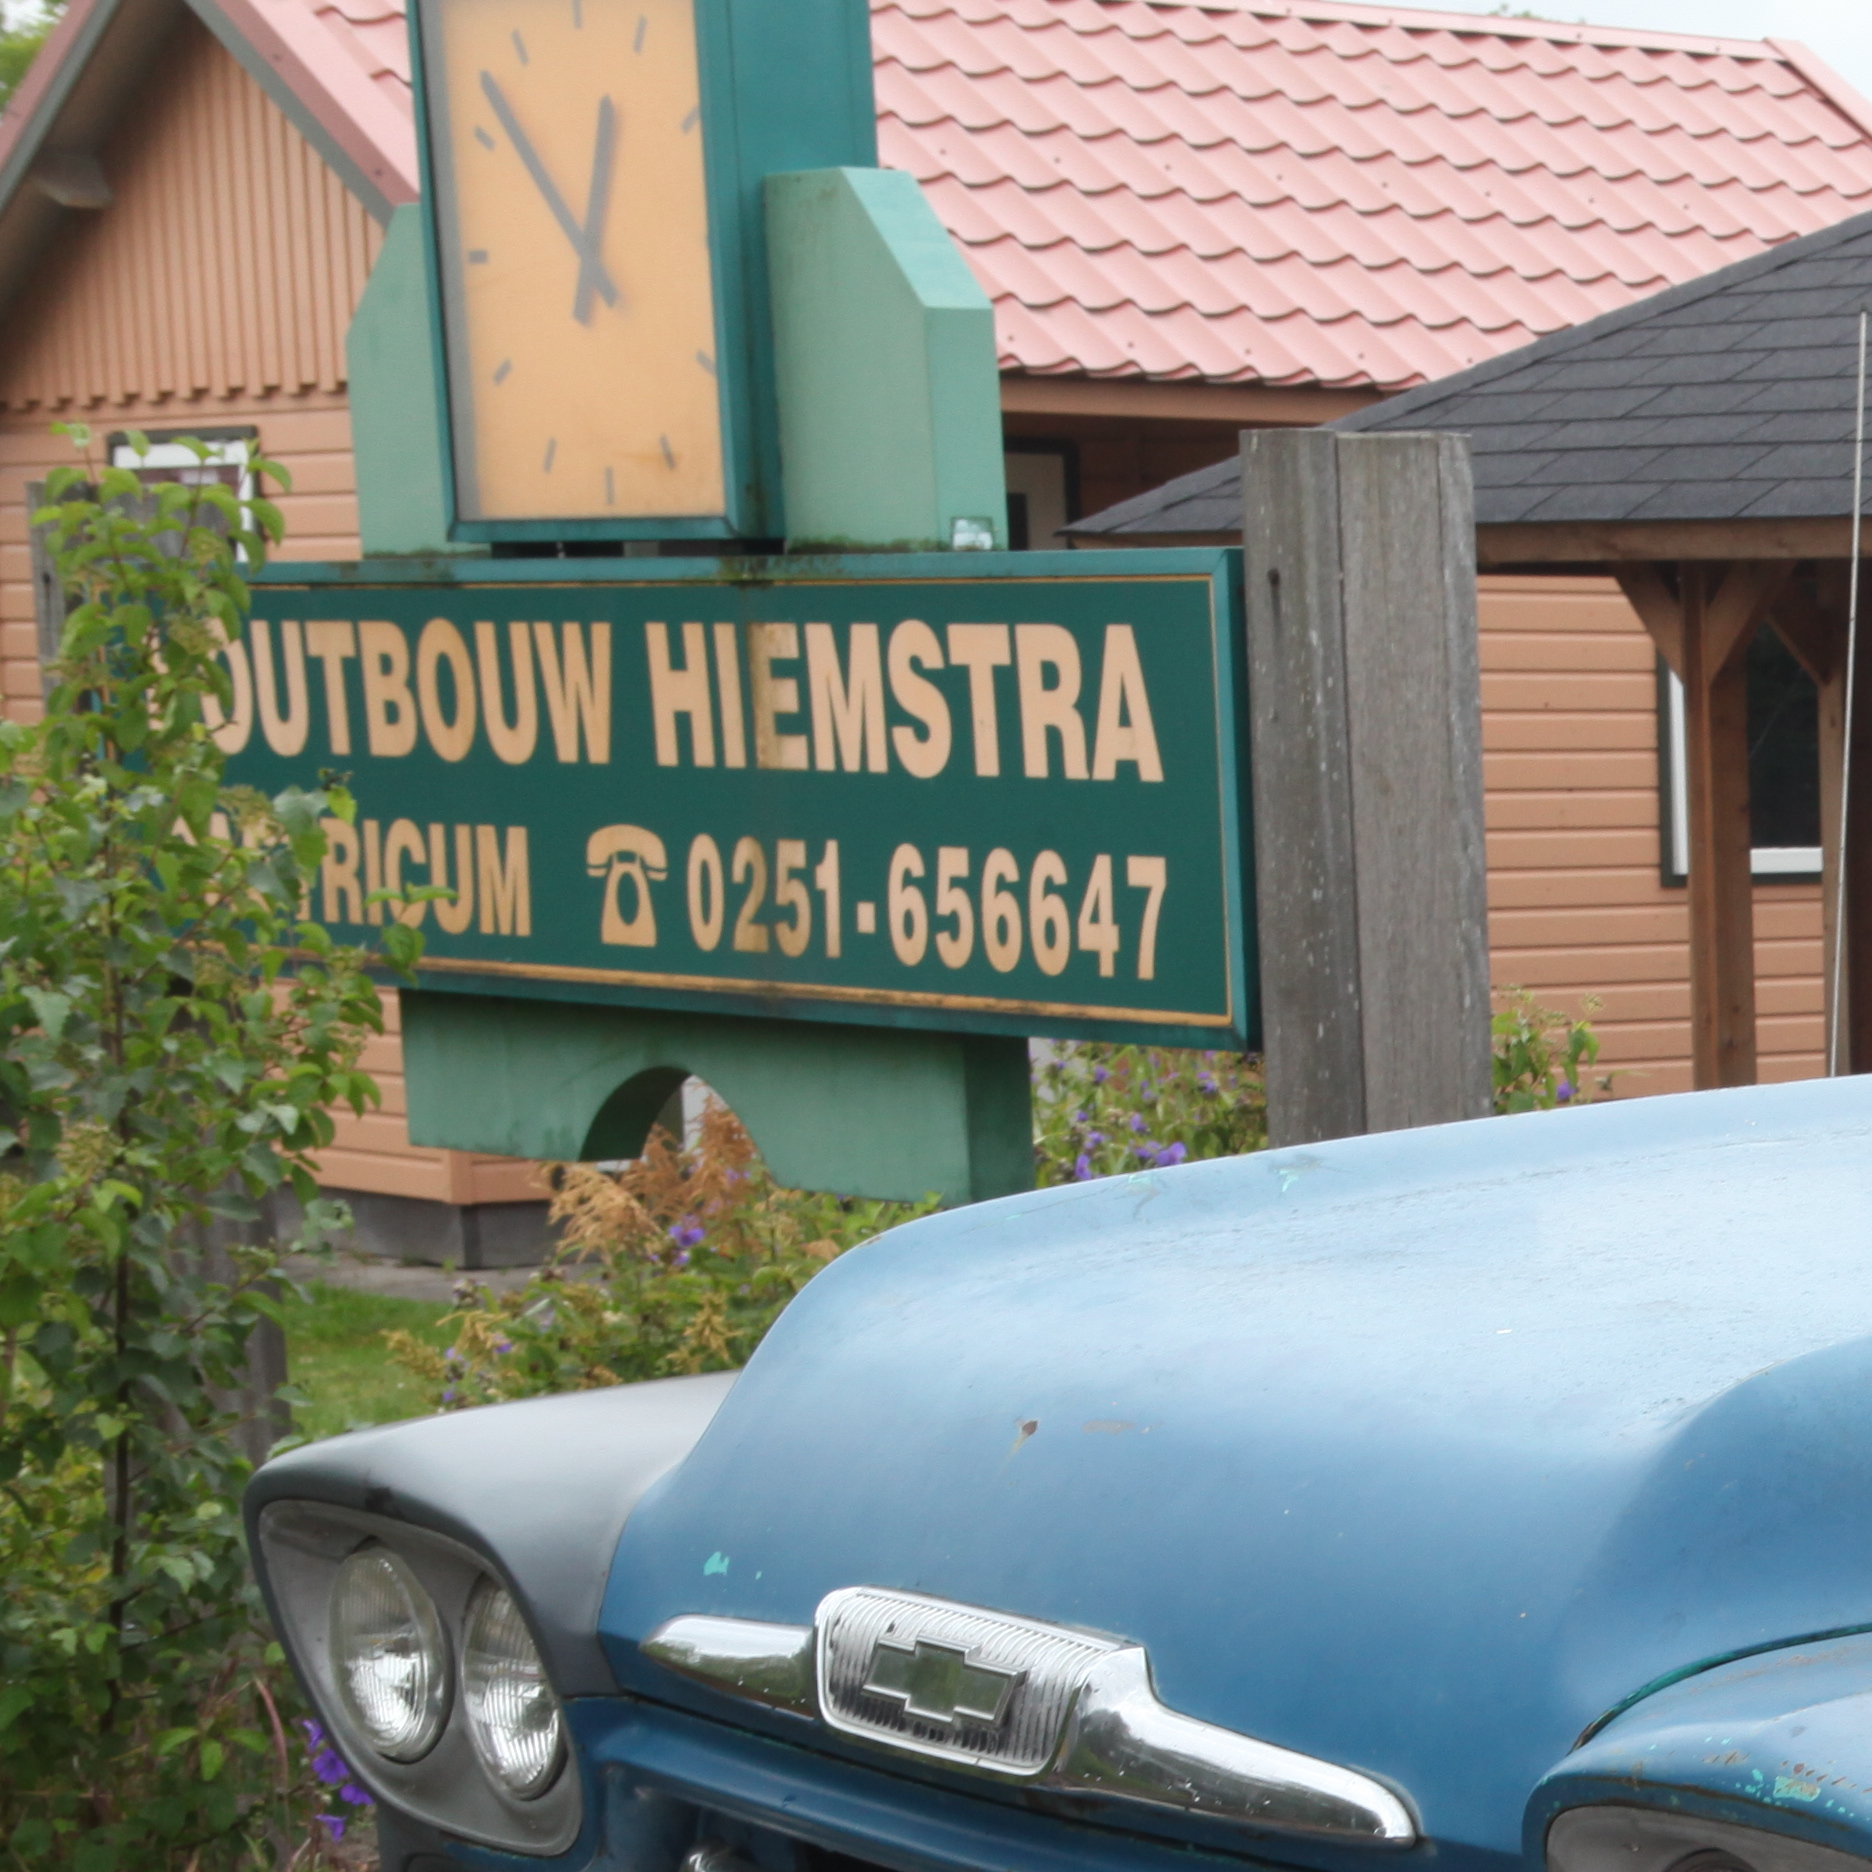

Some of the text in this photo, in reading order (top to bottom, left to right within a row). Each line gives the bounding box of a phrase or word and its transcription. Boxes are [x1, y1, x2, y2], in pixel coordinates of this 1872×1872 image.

[147, 617, 1165, 783] OUTBOUW HIEMSTRA
[170, 814, 1167, 981] RICUM 0251-656647
